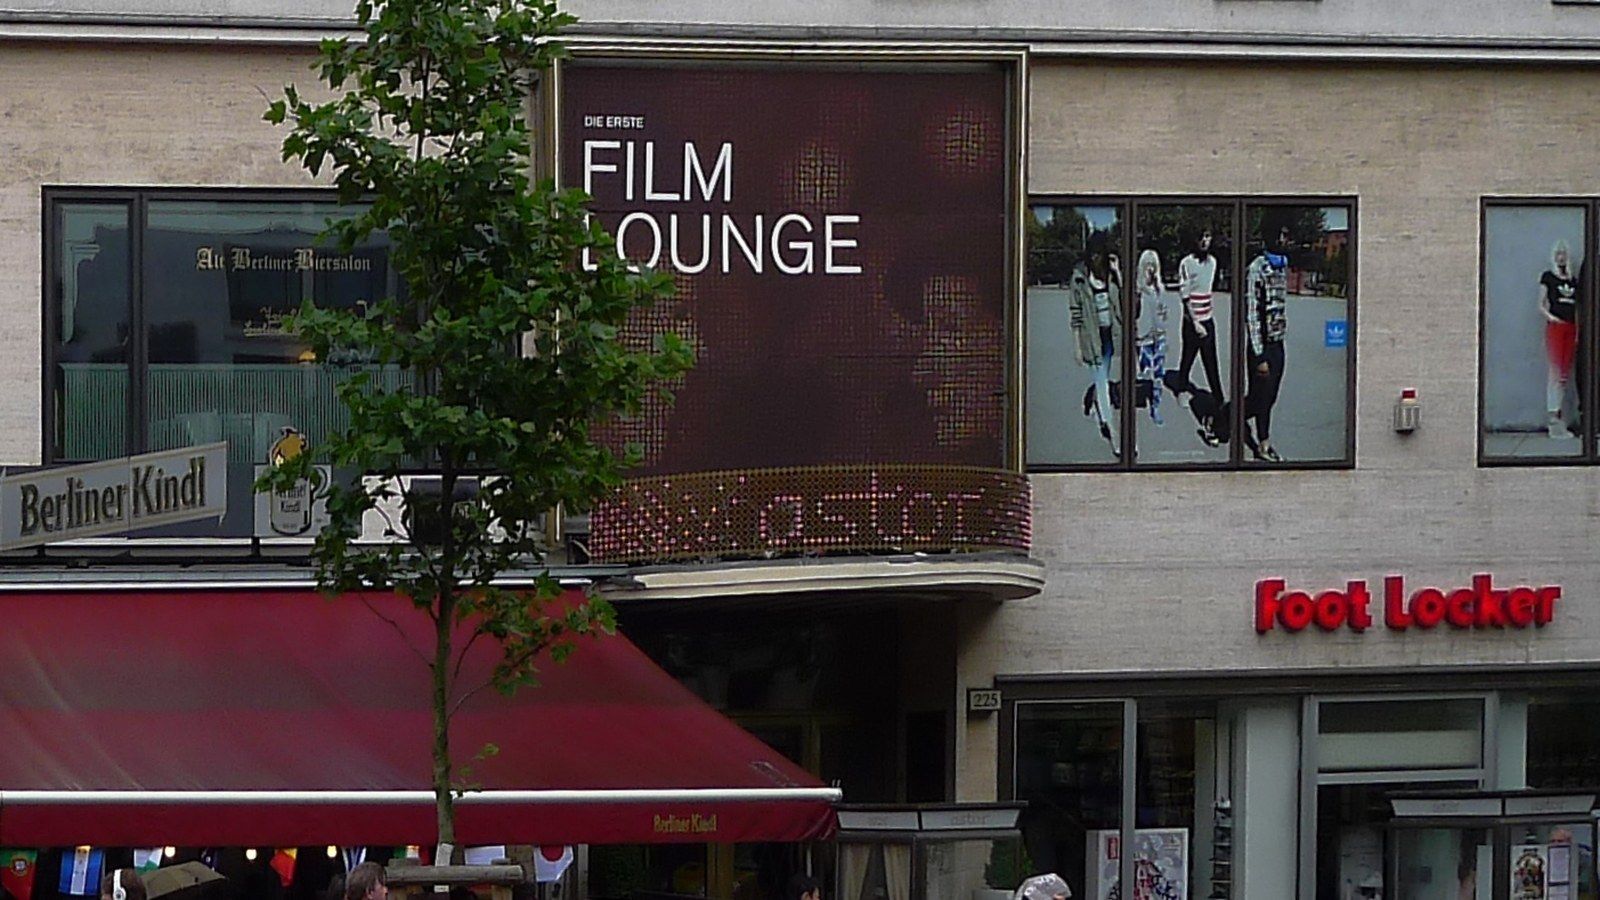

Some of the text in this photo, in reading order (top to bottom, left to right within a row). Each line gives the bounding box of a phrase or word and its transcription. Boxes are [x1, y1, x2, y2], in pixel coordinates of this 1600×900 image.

[584, 115, 645, 129] DIE ERSTE
[583, 139, 734, 202] FILM
[231, 247, 294, 272] Berliner
[293, 248, 371, 272] Biersalon
[20, 456, 206, 536] Berliner Kindl
[1255, 572, 1562, 634] Foot Locker
[973, 692, 998, 707] 225
